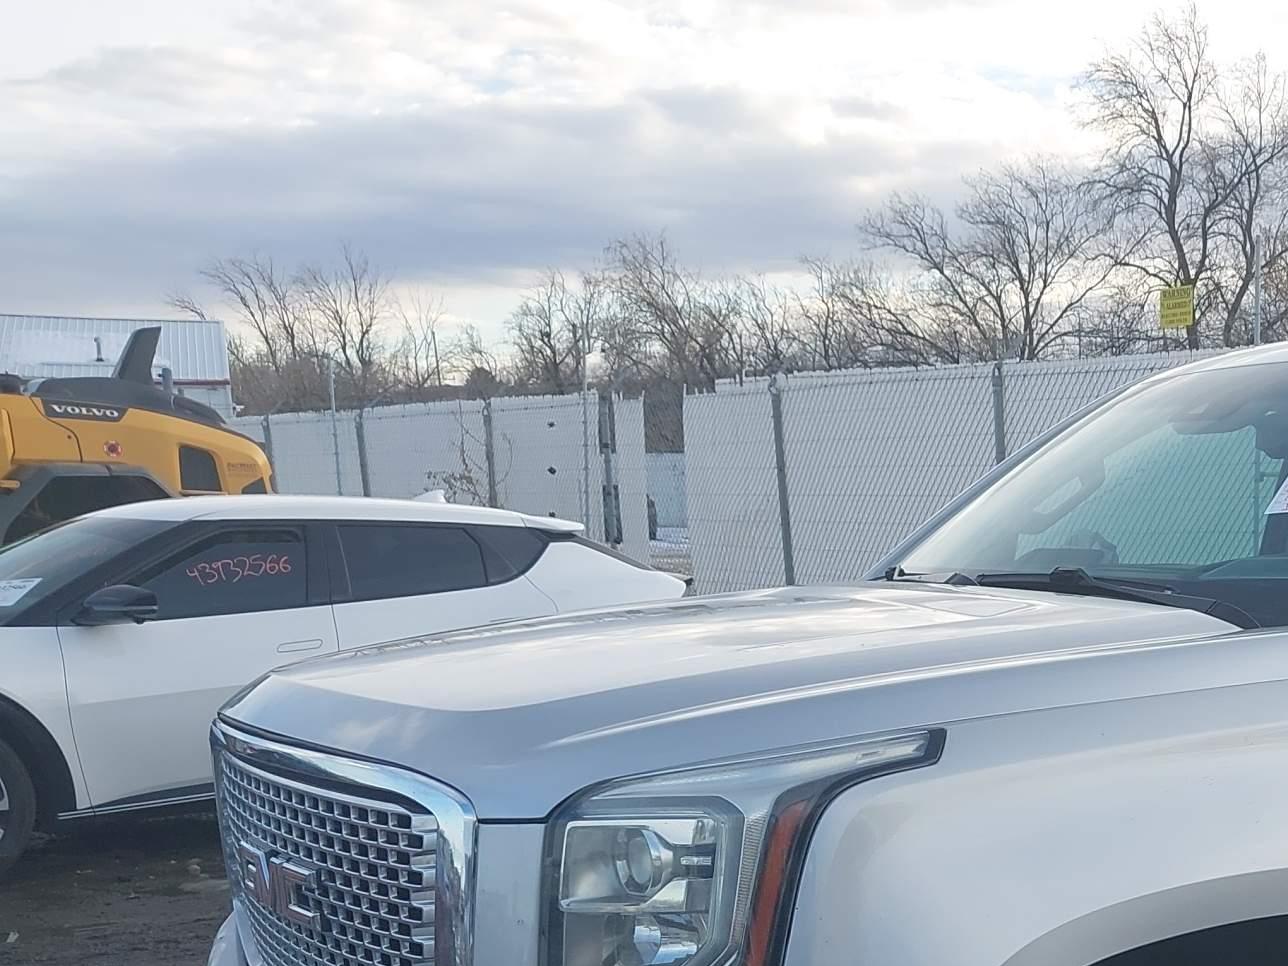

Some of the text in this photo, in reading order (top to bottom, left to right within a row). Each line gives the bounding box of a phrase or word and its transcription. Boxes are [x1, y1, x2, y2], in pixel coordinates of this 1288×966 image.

[49, 404, 119, 418] VOLVO
[185, 554, 292, 586] 43932566
[240, 841, 320, 929] GMC
